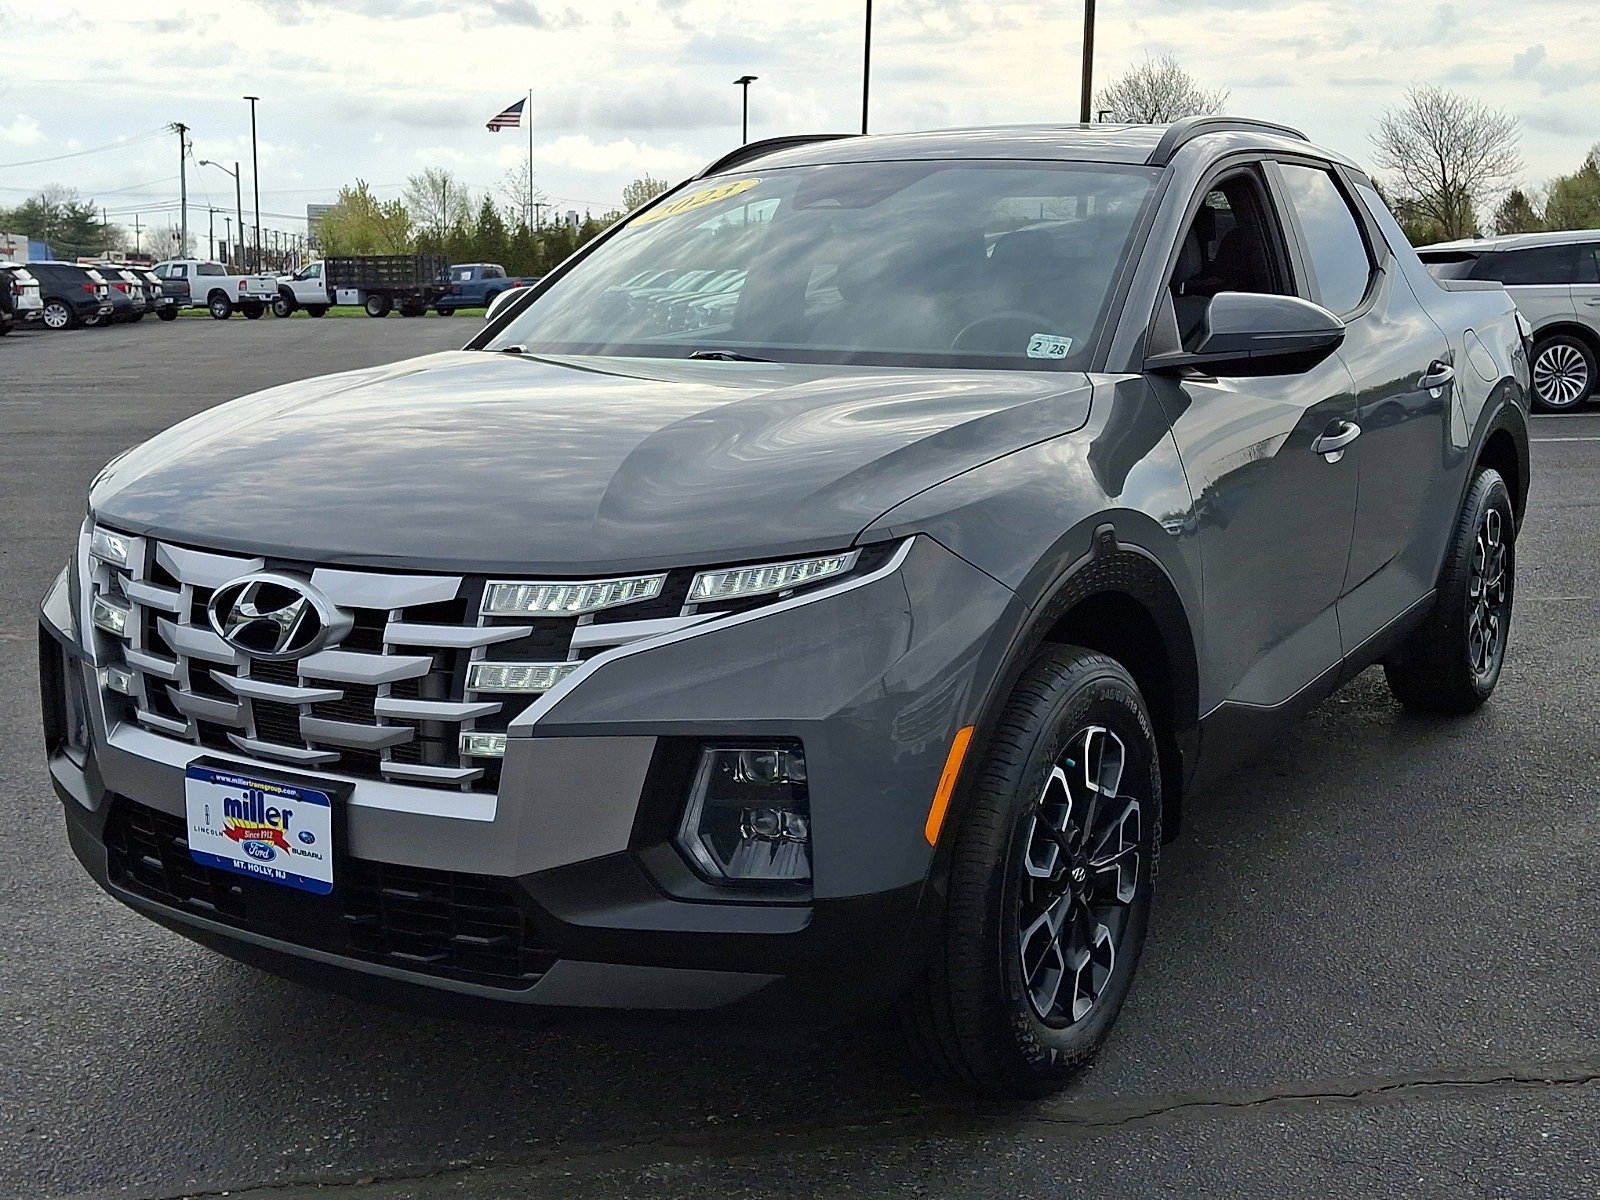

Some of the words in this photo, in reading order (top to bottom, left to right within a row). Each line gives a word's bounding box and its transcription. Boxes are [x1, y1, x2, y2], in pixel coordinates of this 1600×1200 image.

[1032, 341, 1042, 352] 2
[1049, 344, 1066, 355] 28
[215, 774, 297, 796] www.millertransgroup.com
[223, 789, 292, 830] miller
[193, 825, 224, 838] LINCOLN
[244, 830, 260, 839] Since
[260, 831, 273, 839] 1912
[248, 842, 270, 859] Ford
[291, 847, 323, 861] SUBARU
[233, 859, 246, 870] MT.
[247, 863, 274, 878] HOLLY,
[275, 870, 286, 880] NJ
